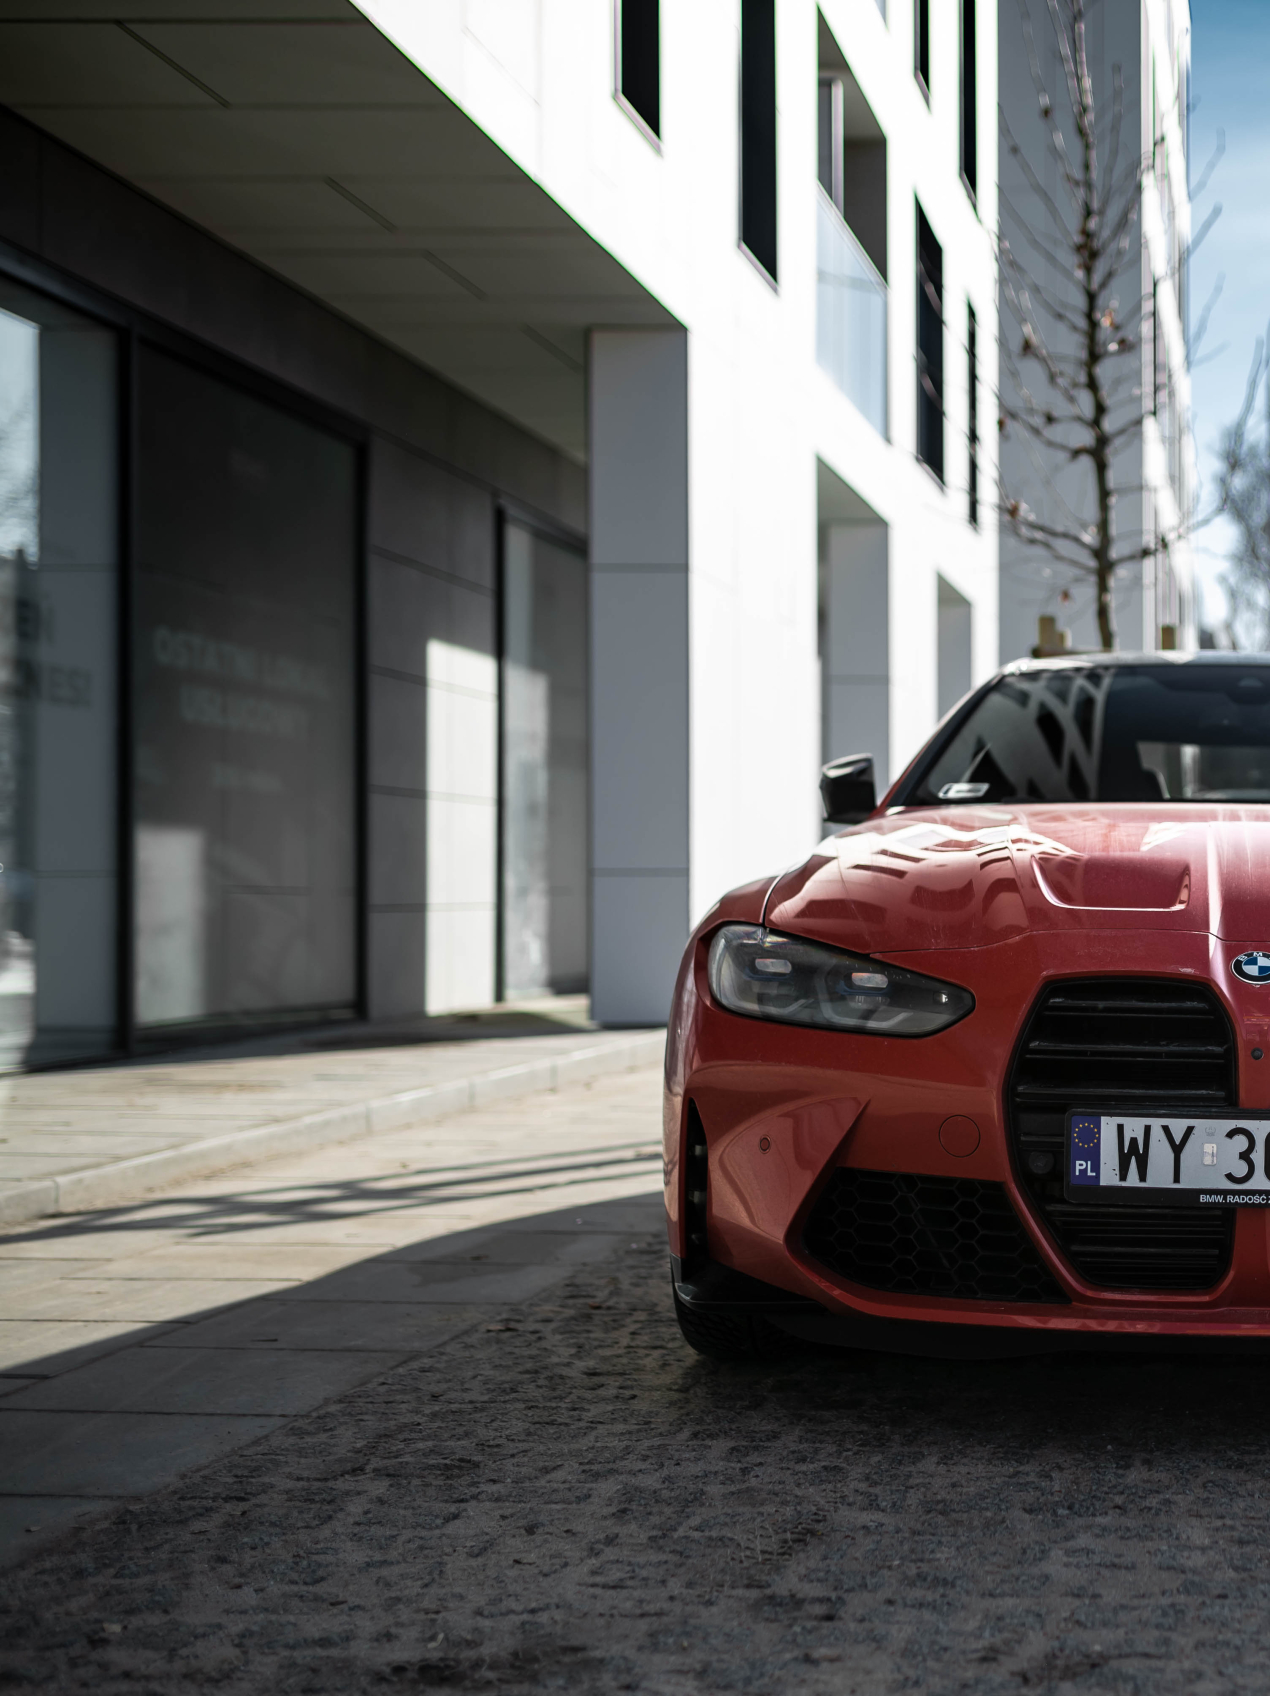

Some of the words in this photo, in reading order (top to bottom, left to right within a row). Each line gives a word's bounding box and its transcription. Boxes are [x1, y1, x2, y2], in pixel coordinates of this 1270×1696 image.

[1116, 1123, 1196, 1184] WY
[1075, 1161, 1096, 1176] PL
[1199, 1194, 1225, 1203] BMW.
[1226, 1193, 1267, 1204] RADOŚĆ
